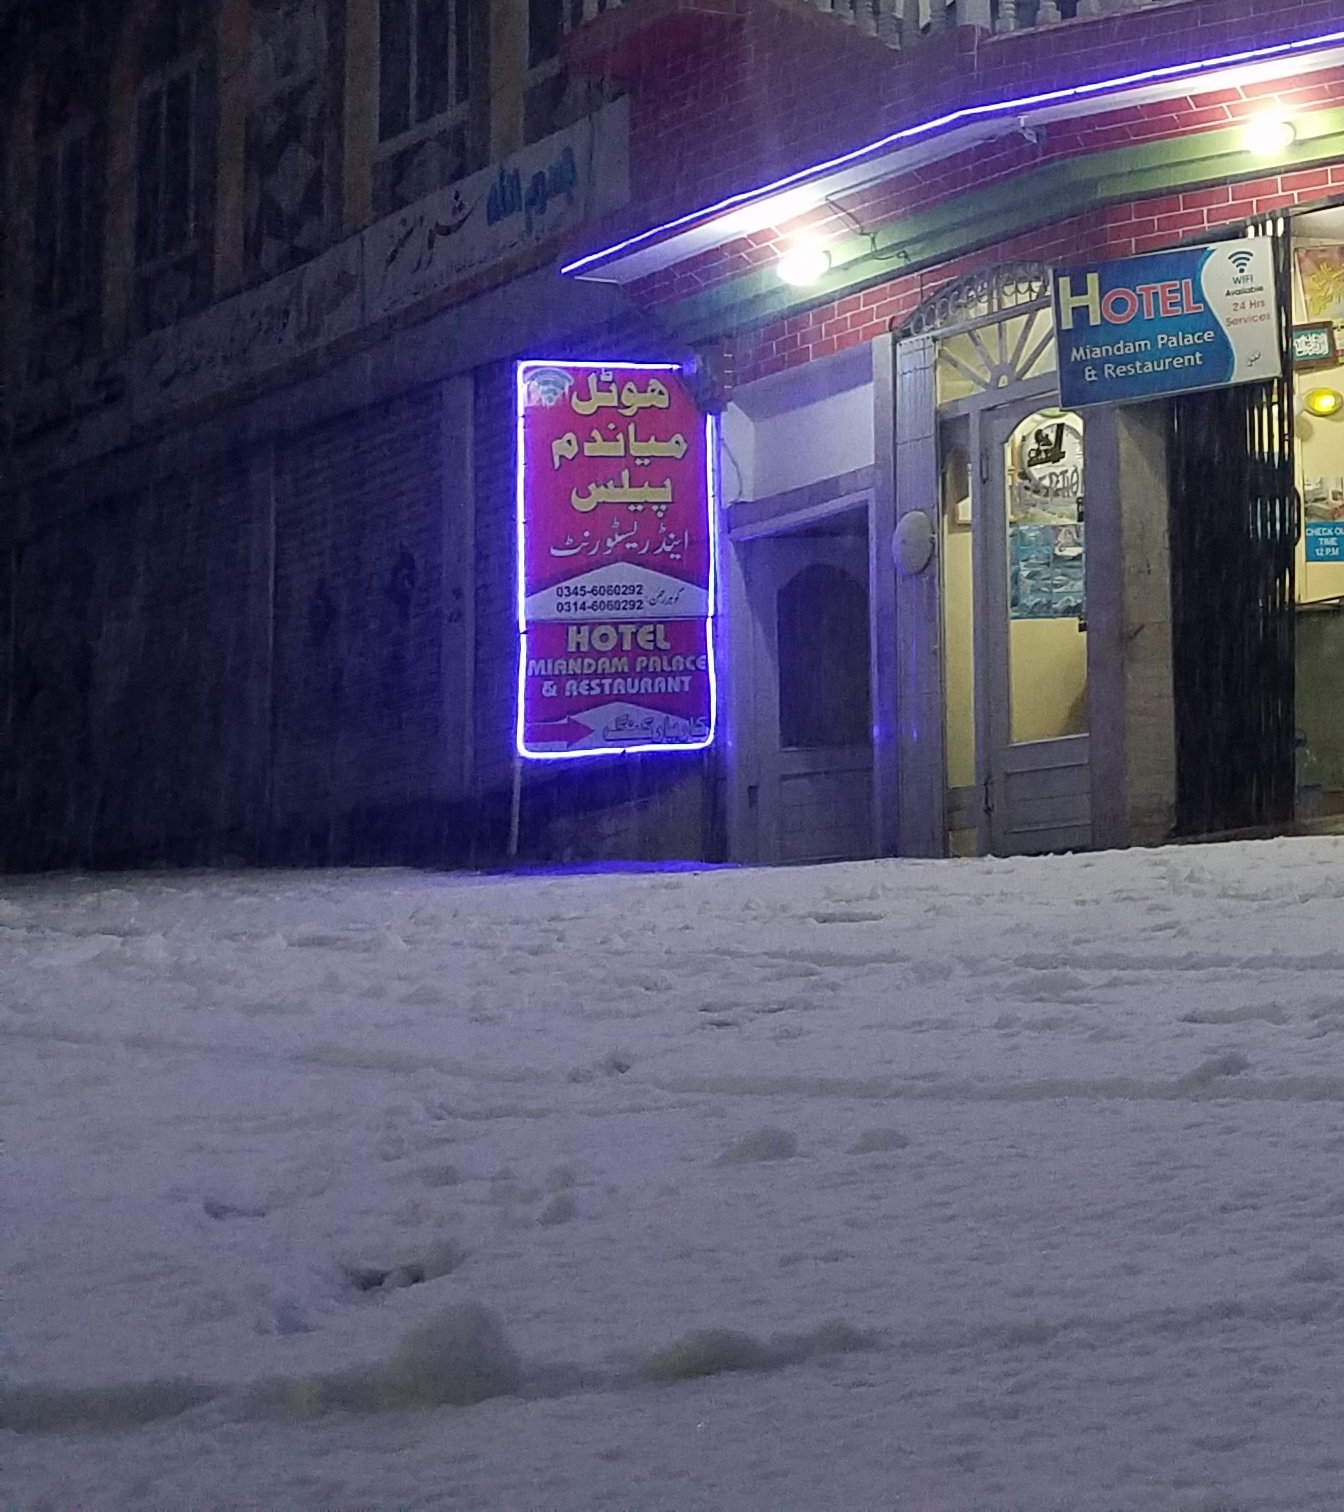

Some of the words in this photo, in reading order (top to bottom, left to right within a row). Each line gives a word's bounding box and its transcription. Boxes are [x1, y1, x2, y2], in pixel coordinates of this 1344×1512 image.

[1058, 272, 1205, 330] HOTEL
[1225, 285, 1264, 297] Available
[1226, 312, 1272, 327] Services
[1232, 301, 1246, 312] 24
[1249, 299, 1266, 309] Hrs
[1070, 338, 1151, 362] Miandam
[1157, 330, 1215, 349] Palace
[1084, 366, 1099, 382] &
[1104, 352, 1203, 379] Restaurent
[550, 422, 689, 470] میاندم
[570, 469, 674, 518] پیلس
[567, 624, 672, 652] HOTEL
[527, 656, 630, 677] MIANDAM
[636, 654, 707, 672] PALACE
[541, 680, 557, 697] &
[564, 676, 692, 697] RESTAURANT
